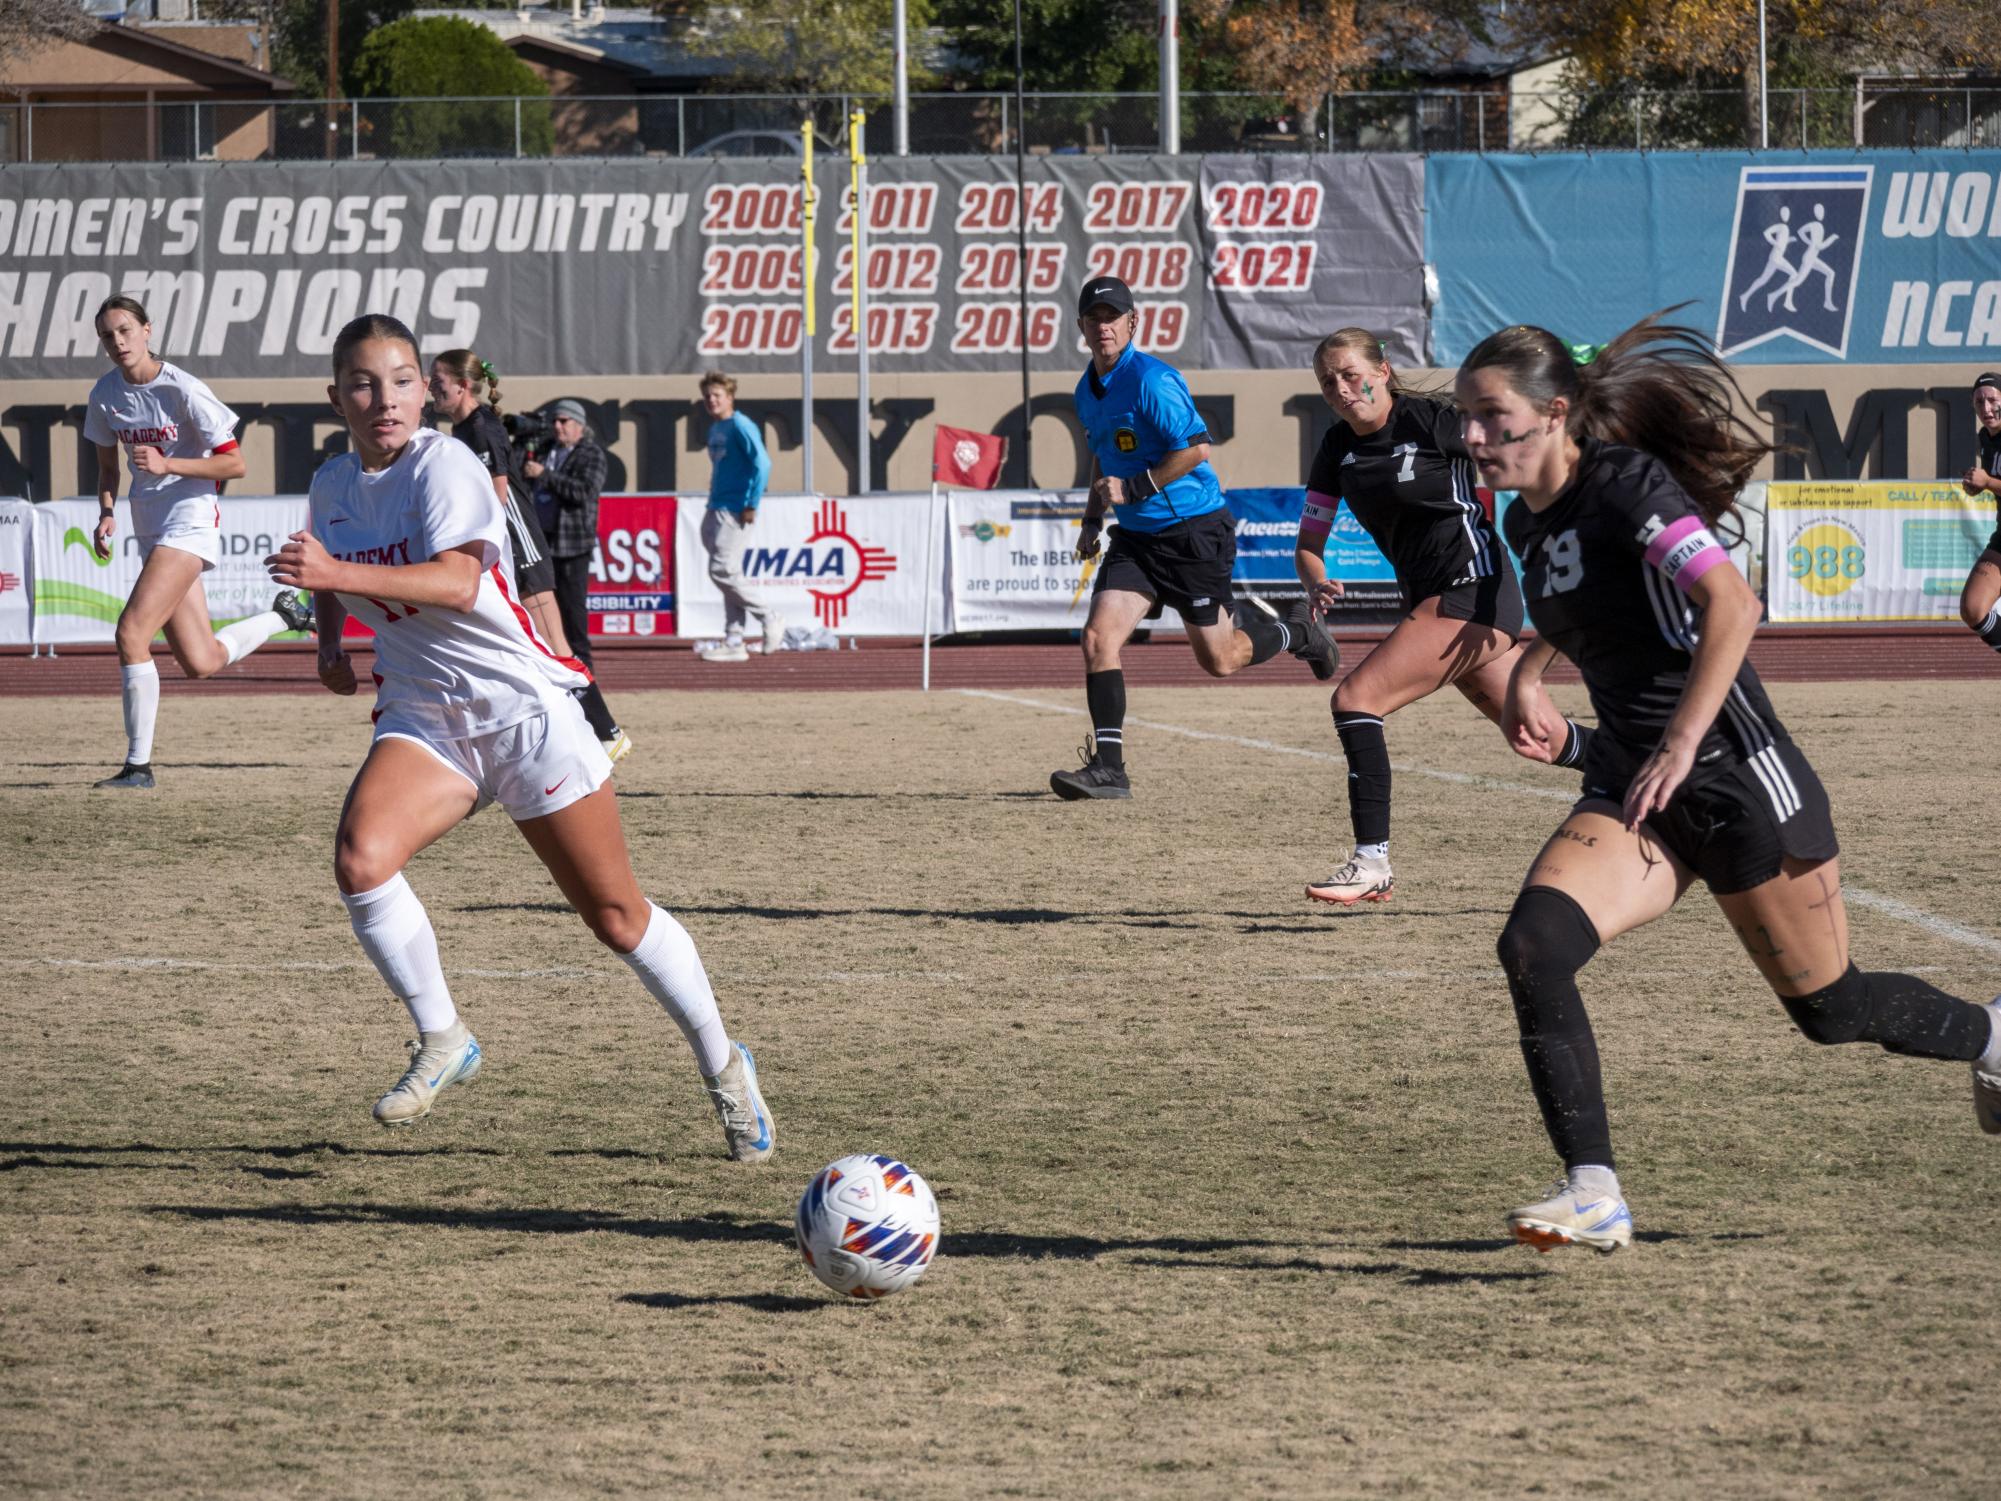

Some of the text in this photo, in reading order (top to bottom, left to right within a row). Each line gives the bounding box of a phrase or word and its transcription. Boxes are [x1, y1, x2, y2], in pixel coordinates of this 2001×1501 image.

[218, 195, 407, 255] CROSS
[422, 192, 690, 253] COUNTRY
[1084, 180, 1192, 233] 2017
[1208, 181, 1323, 232] 2020
[1881, 171, 2001, 238] WO
[1208, 241, 1316, 291] 2021
[697, 302, 802, 355] 2010
[118, 424, 178, 443] ACADEMY
[1391, 441, 1418, 482] 7
[1814, 485, 1855, 494] emotional
[1843, 499, 1873, 509] support
[1887, 490, 1919, 501] CALL
[1930, 490, 1960, 502] TEXT
[1011, 551, 1038, 566] The
[1541, 528, 1584, 598] 19
[1663, 536, 1707, 577] CAPTAIN
[1787, 545, 1866, 579] 988
[967, 579, 990, 591] are
[995, 575, 1040, 594] proud
[1045, 577, 1059, 591] to
